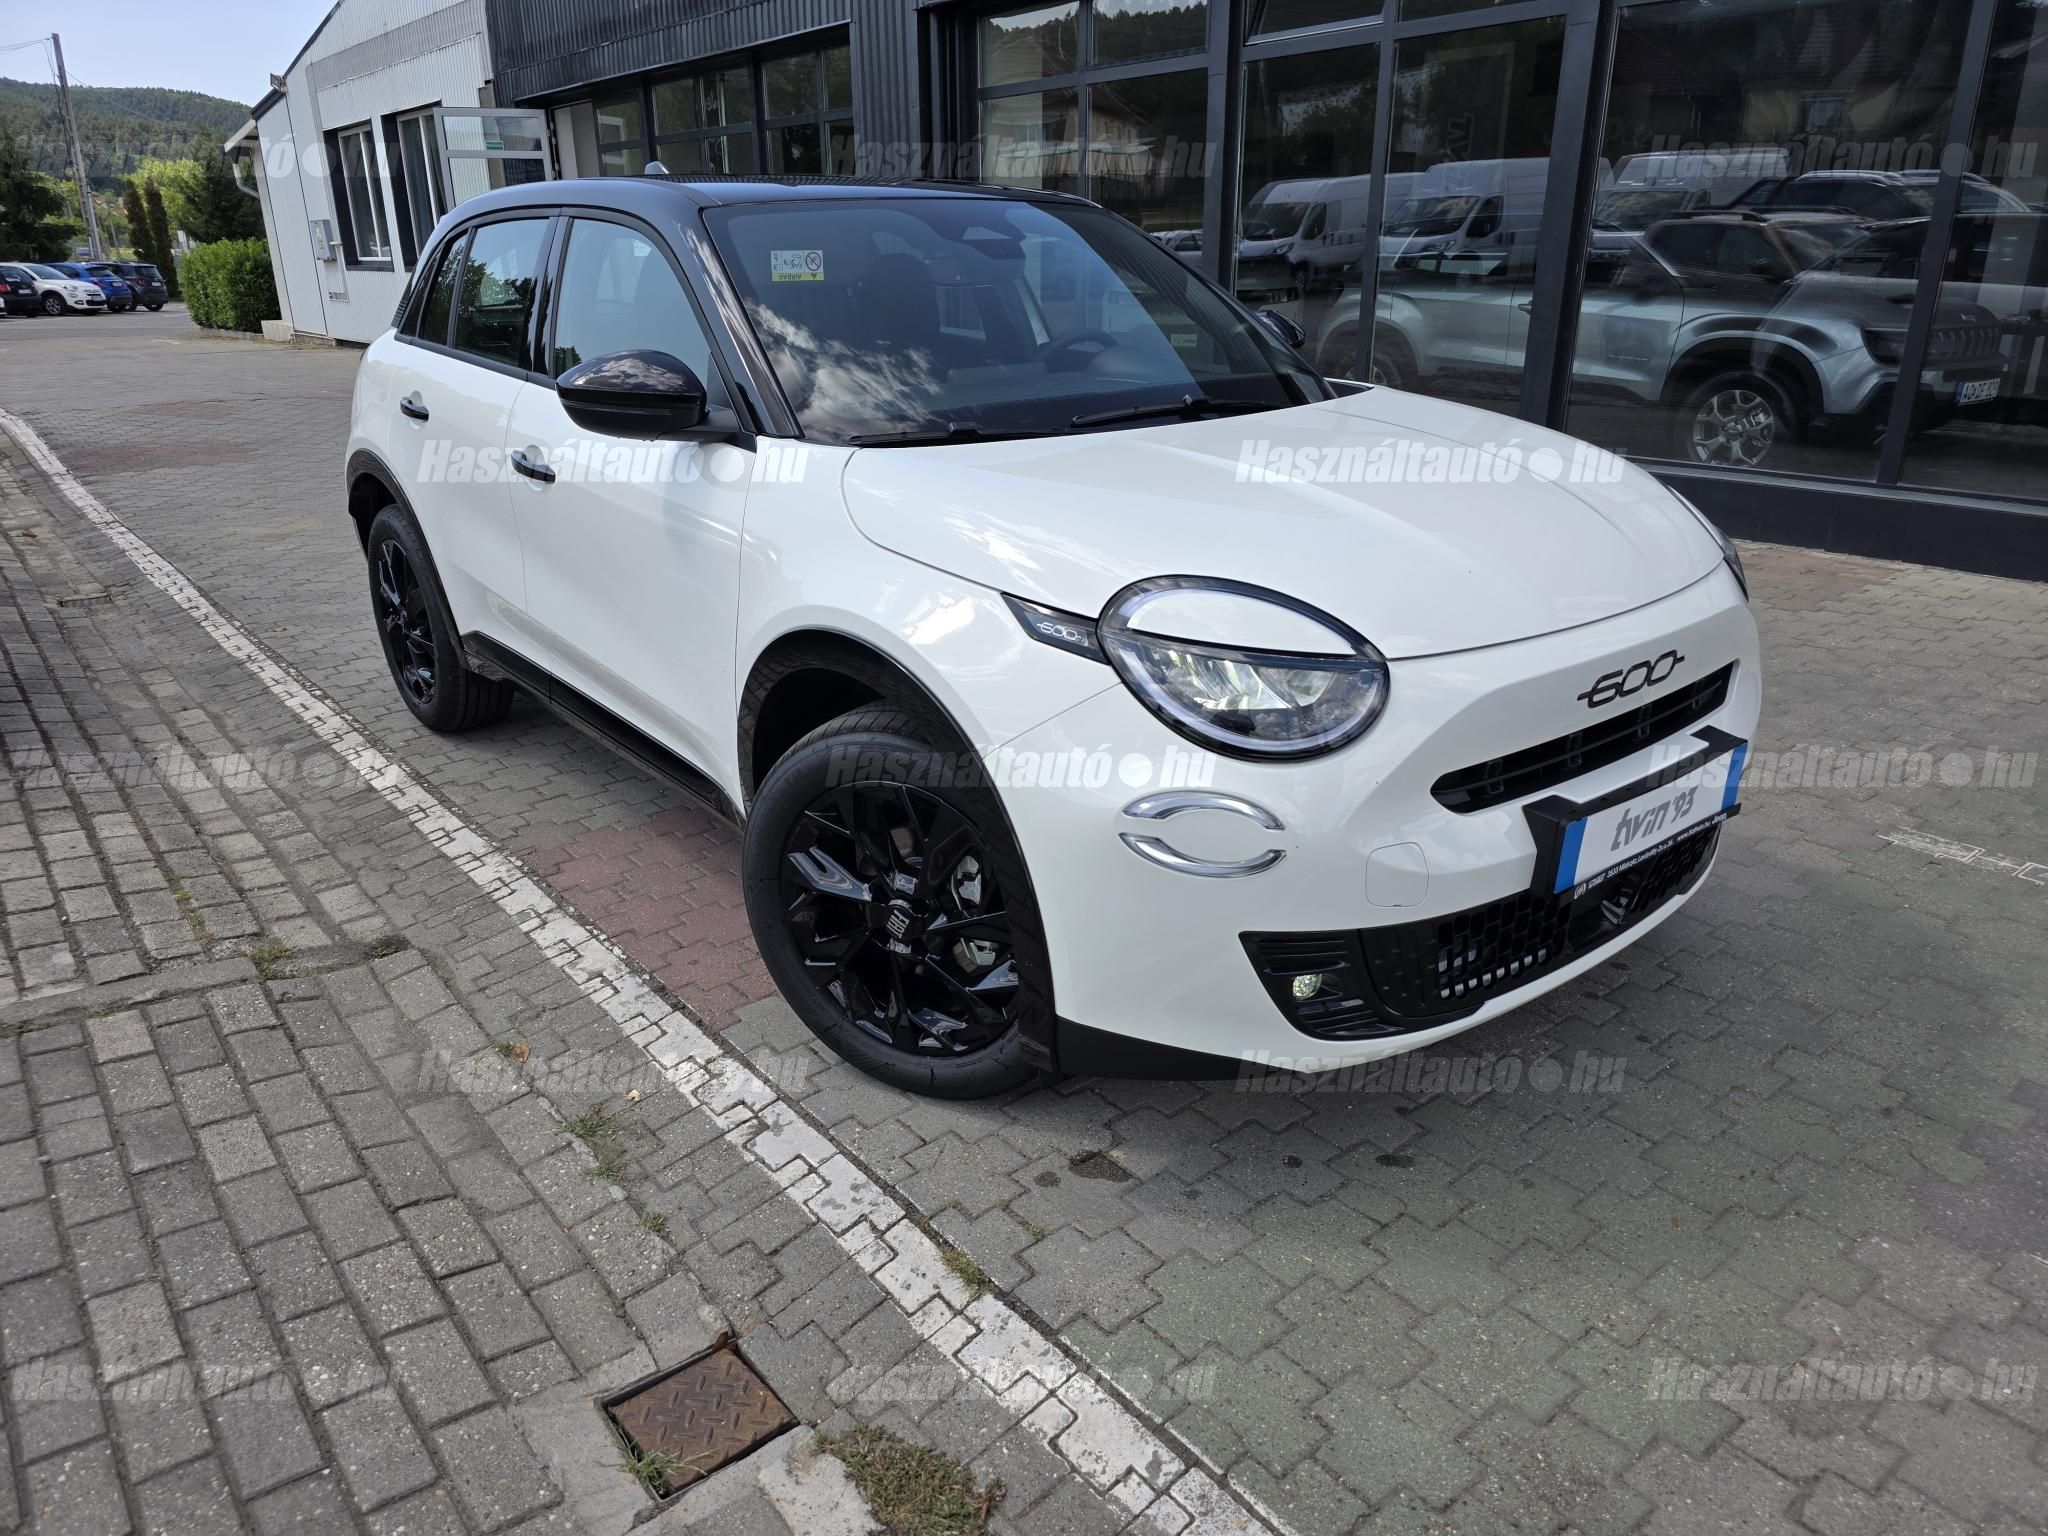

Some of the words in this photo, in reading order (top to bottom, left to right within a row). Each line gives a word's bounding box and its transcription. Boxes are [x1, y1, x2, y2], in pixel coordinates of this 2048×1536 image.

[1037, 621, 1081, 641] 600
[1579, 649, 1684, 709] 600
[886, 909, 910, 939] FIAT
